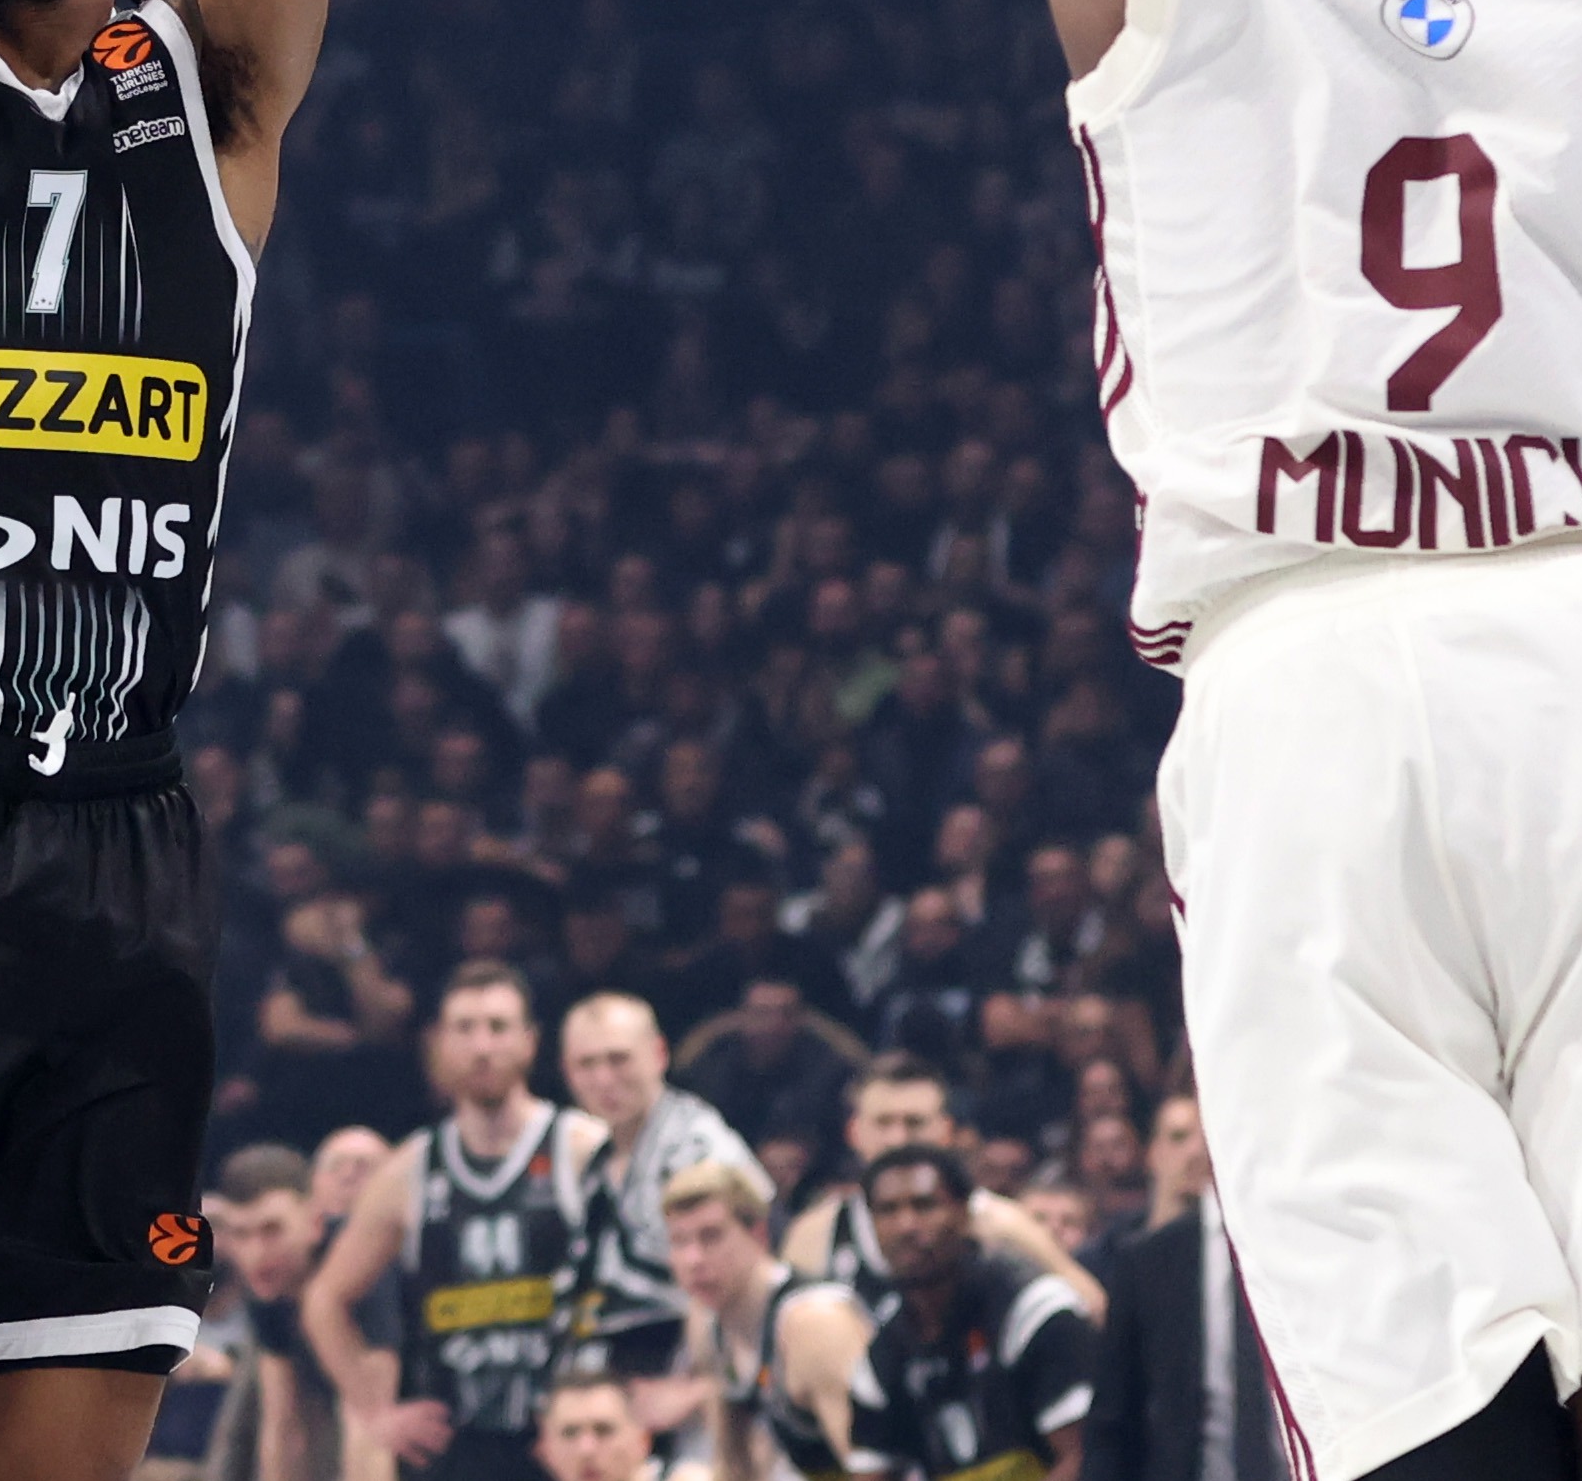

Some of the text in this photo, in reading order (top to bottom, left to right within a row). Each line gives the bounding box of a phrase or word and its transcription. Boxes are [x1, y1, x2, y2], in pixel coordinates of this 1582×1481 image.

[109, 59, 163, 86] TURKISH
[115, 69, 166, 95] AIRLINES
[117, 80, 169, 101] EuroLeague
[25, 169, 89, 314] 7
[1361, 132, 1503, 412] 9
[51, 494, 192, 579] NIS
